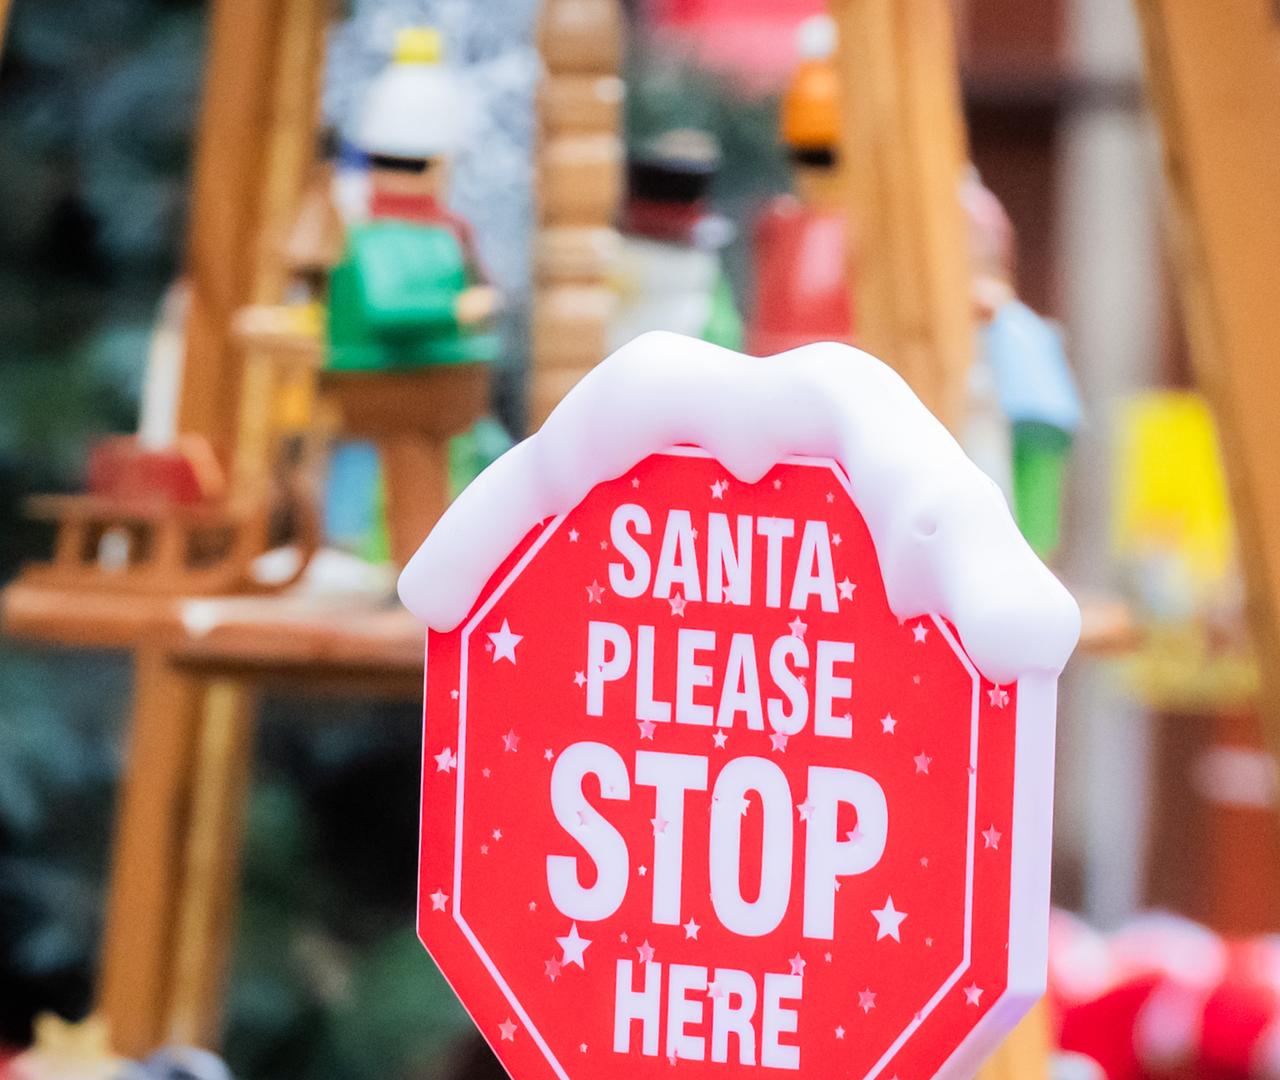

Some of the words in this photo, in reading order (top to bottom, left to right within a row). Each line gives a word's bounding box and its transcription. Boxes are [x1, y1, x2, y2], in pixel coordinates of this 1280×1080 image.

[608, 503, 839, 613] SANTA
[586, 620, 855, 738] PLEASE
[546, 741, 888, 940] STOP
[613, 959, 804, 1070] HERE
